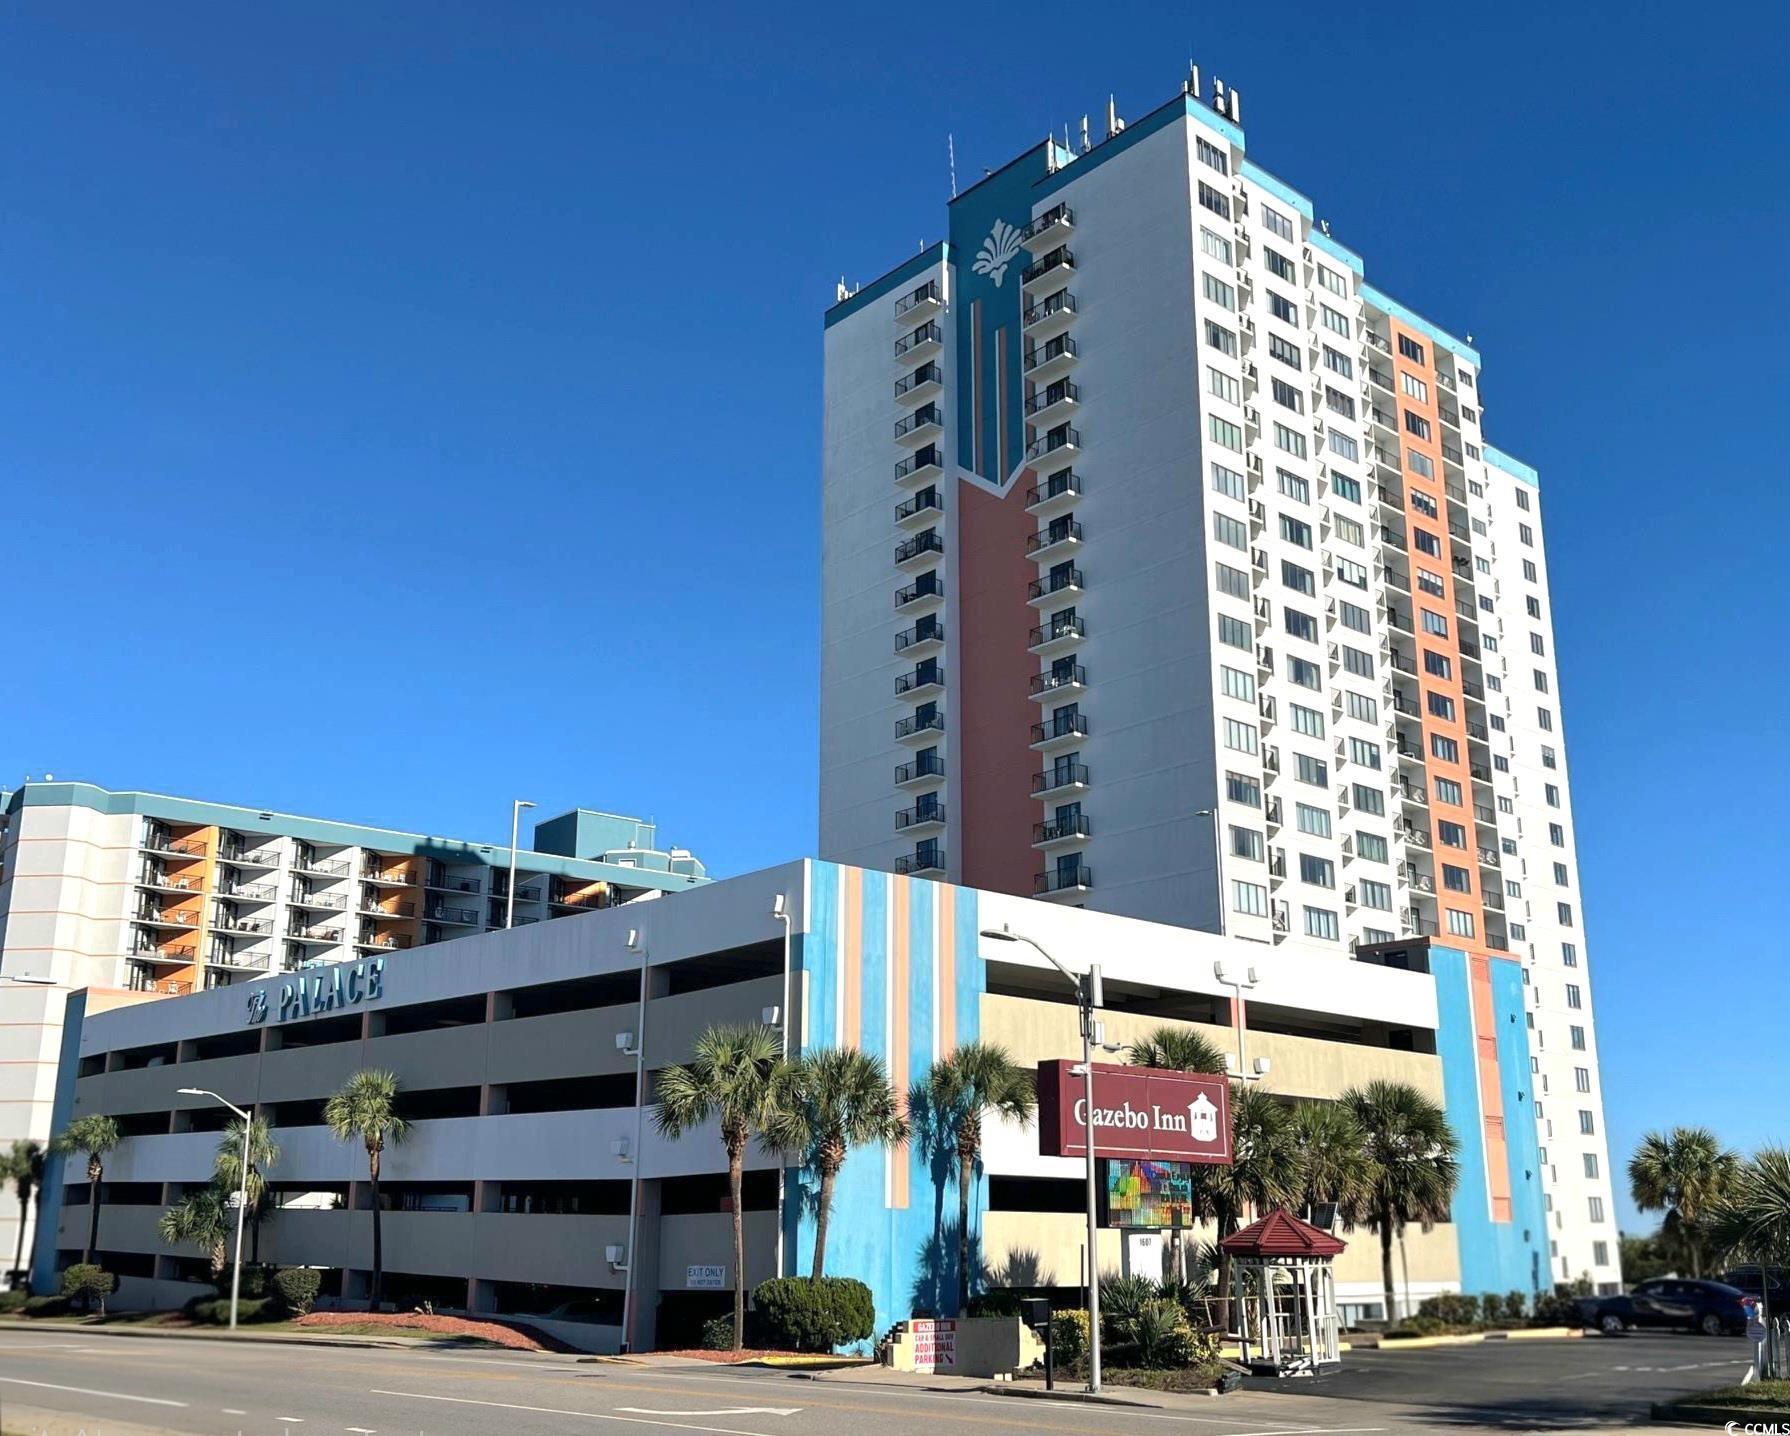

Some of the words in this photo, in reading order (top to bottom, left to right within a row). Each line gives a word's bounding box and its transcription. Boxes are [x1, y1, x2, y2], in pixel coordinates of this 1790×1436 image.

[278, 959, 384, 1022] PALACE
[1074, 1098, 1149, 1129] Gazebo
[1152, 1105, 1188, 1132] Inn
[688, 1267, 704, 1277] EXIT
[705, 1267, 724, 1278] ONLY
[914, 1342, 955, 1353] ADDITIONAL
[914, 1353, 944, 1364] PARKING
